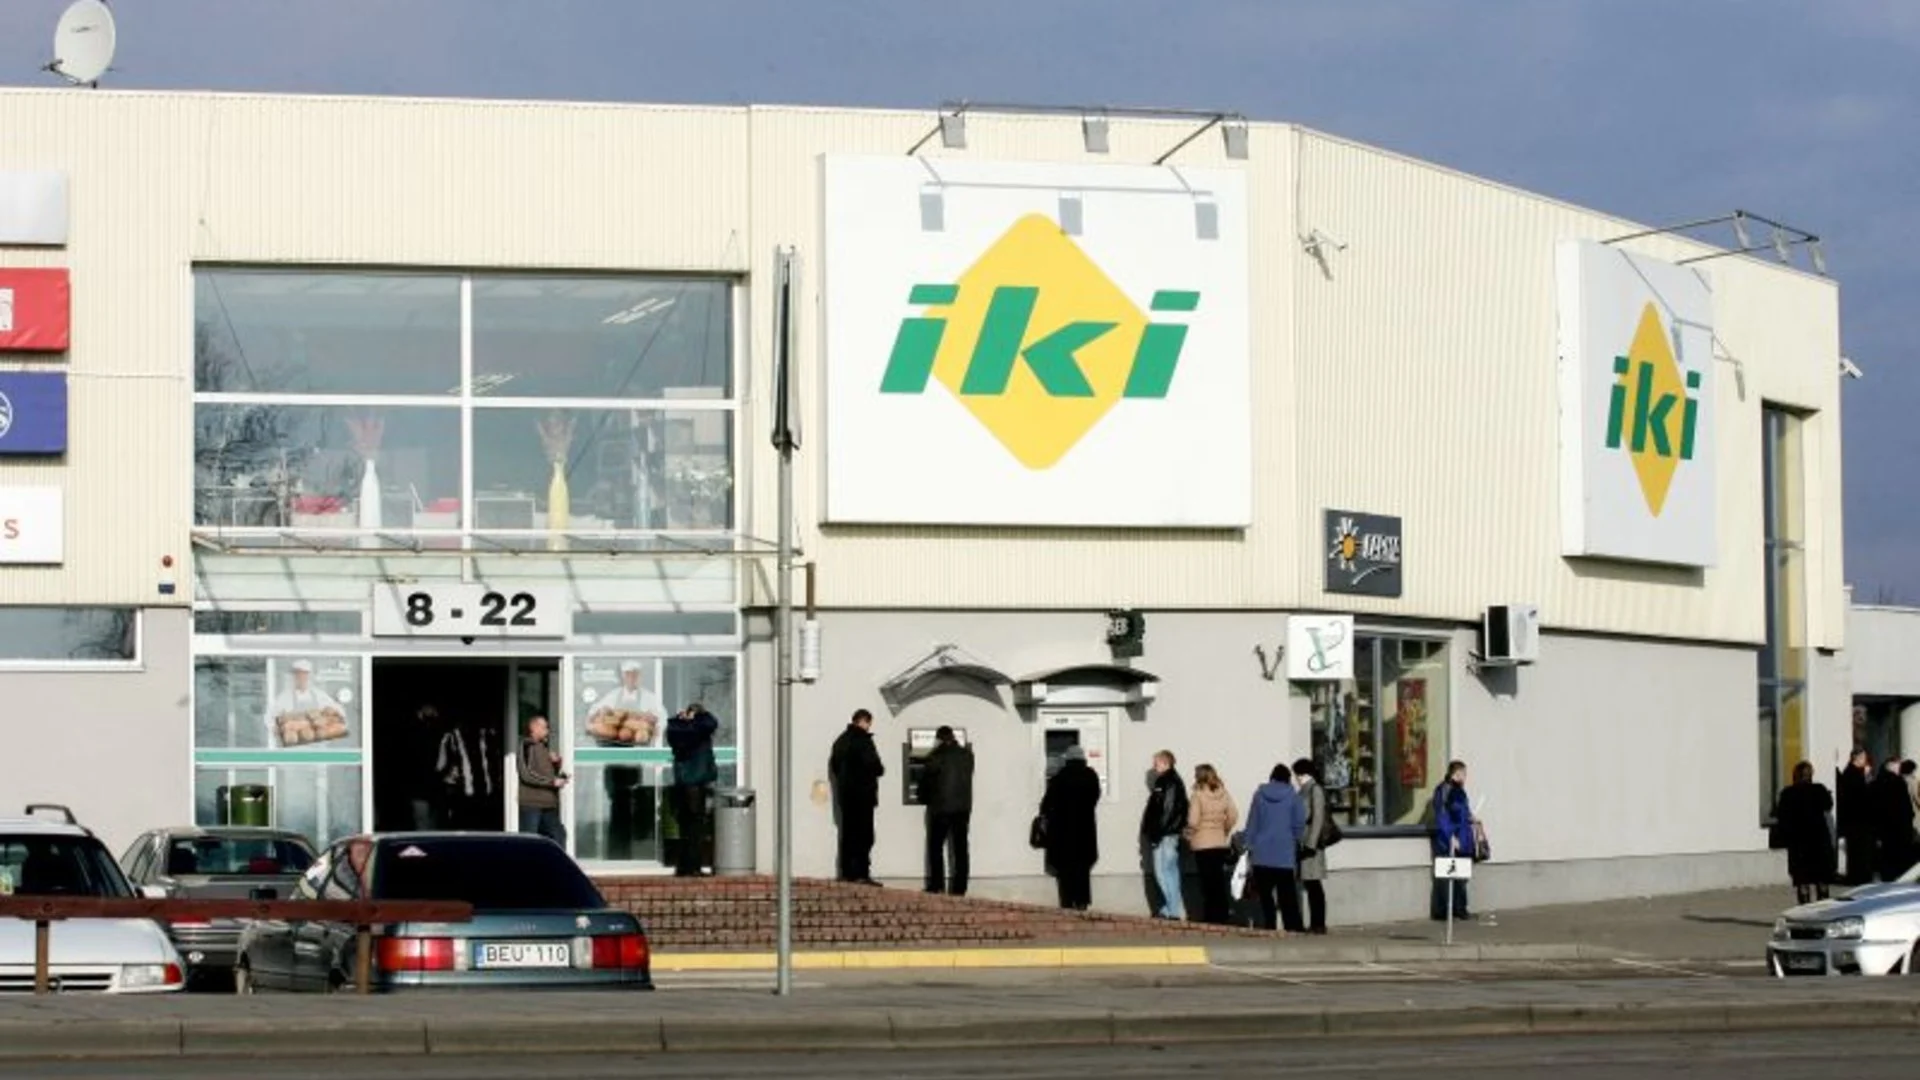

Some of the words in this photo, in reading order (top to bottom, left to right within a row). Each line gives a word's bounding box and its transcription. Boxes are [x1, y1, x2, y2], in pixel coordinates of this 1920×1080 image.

[879, 283, 1201, 399] iki
[1605, 355, 1701, 461] iki
[406, 591, 435, 627] 8
[480, 591, 537, 626] 22
